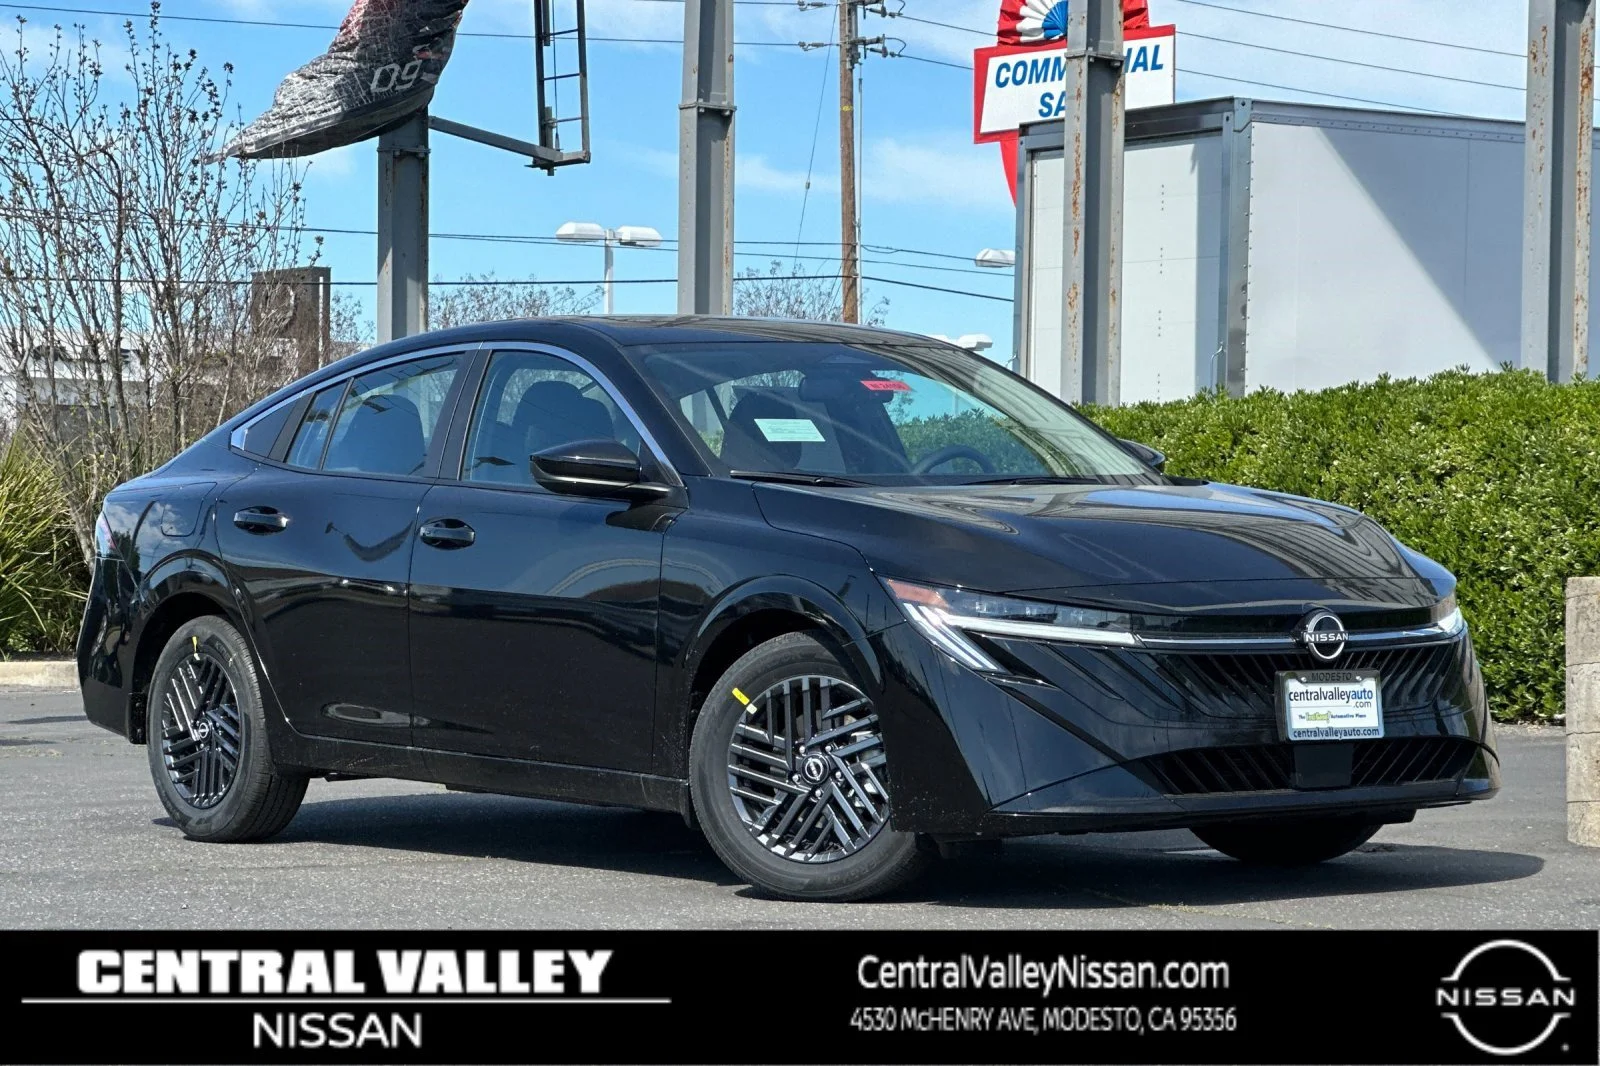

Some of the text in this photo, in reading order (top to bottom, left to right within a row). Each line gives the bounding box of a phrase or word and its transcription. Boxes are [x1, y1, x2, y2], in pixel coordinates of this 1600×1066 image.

[995, 44, 1164, 88] COMMIAL
[1304, 632, 1349, 642] NISSAN
[1311, 672, 1352, 681] MODESTO
[1288, 687, 1373, 704] centralvalleyauto
[1293, 726, 1380, 740] centralvalleyauto.com
